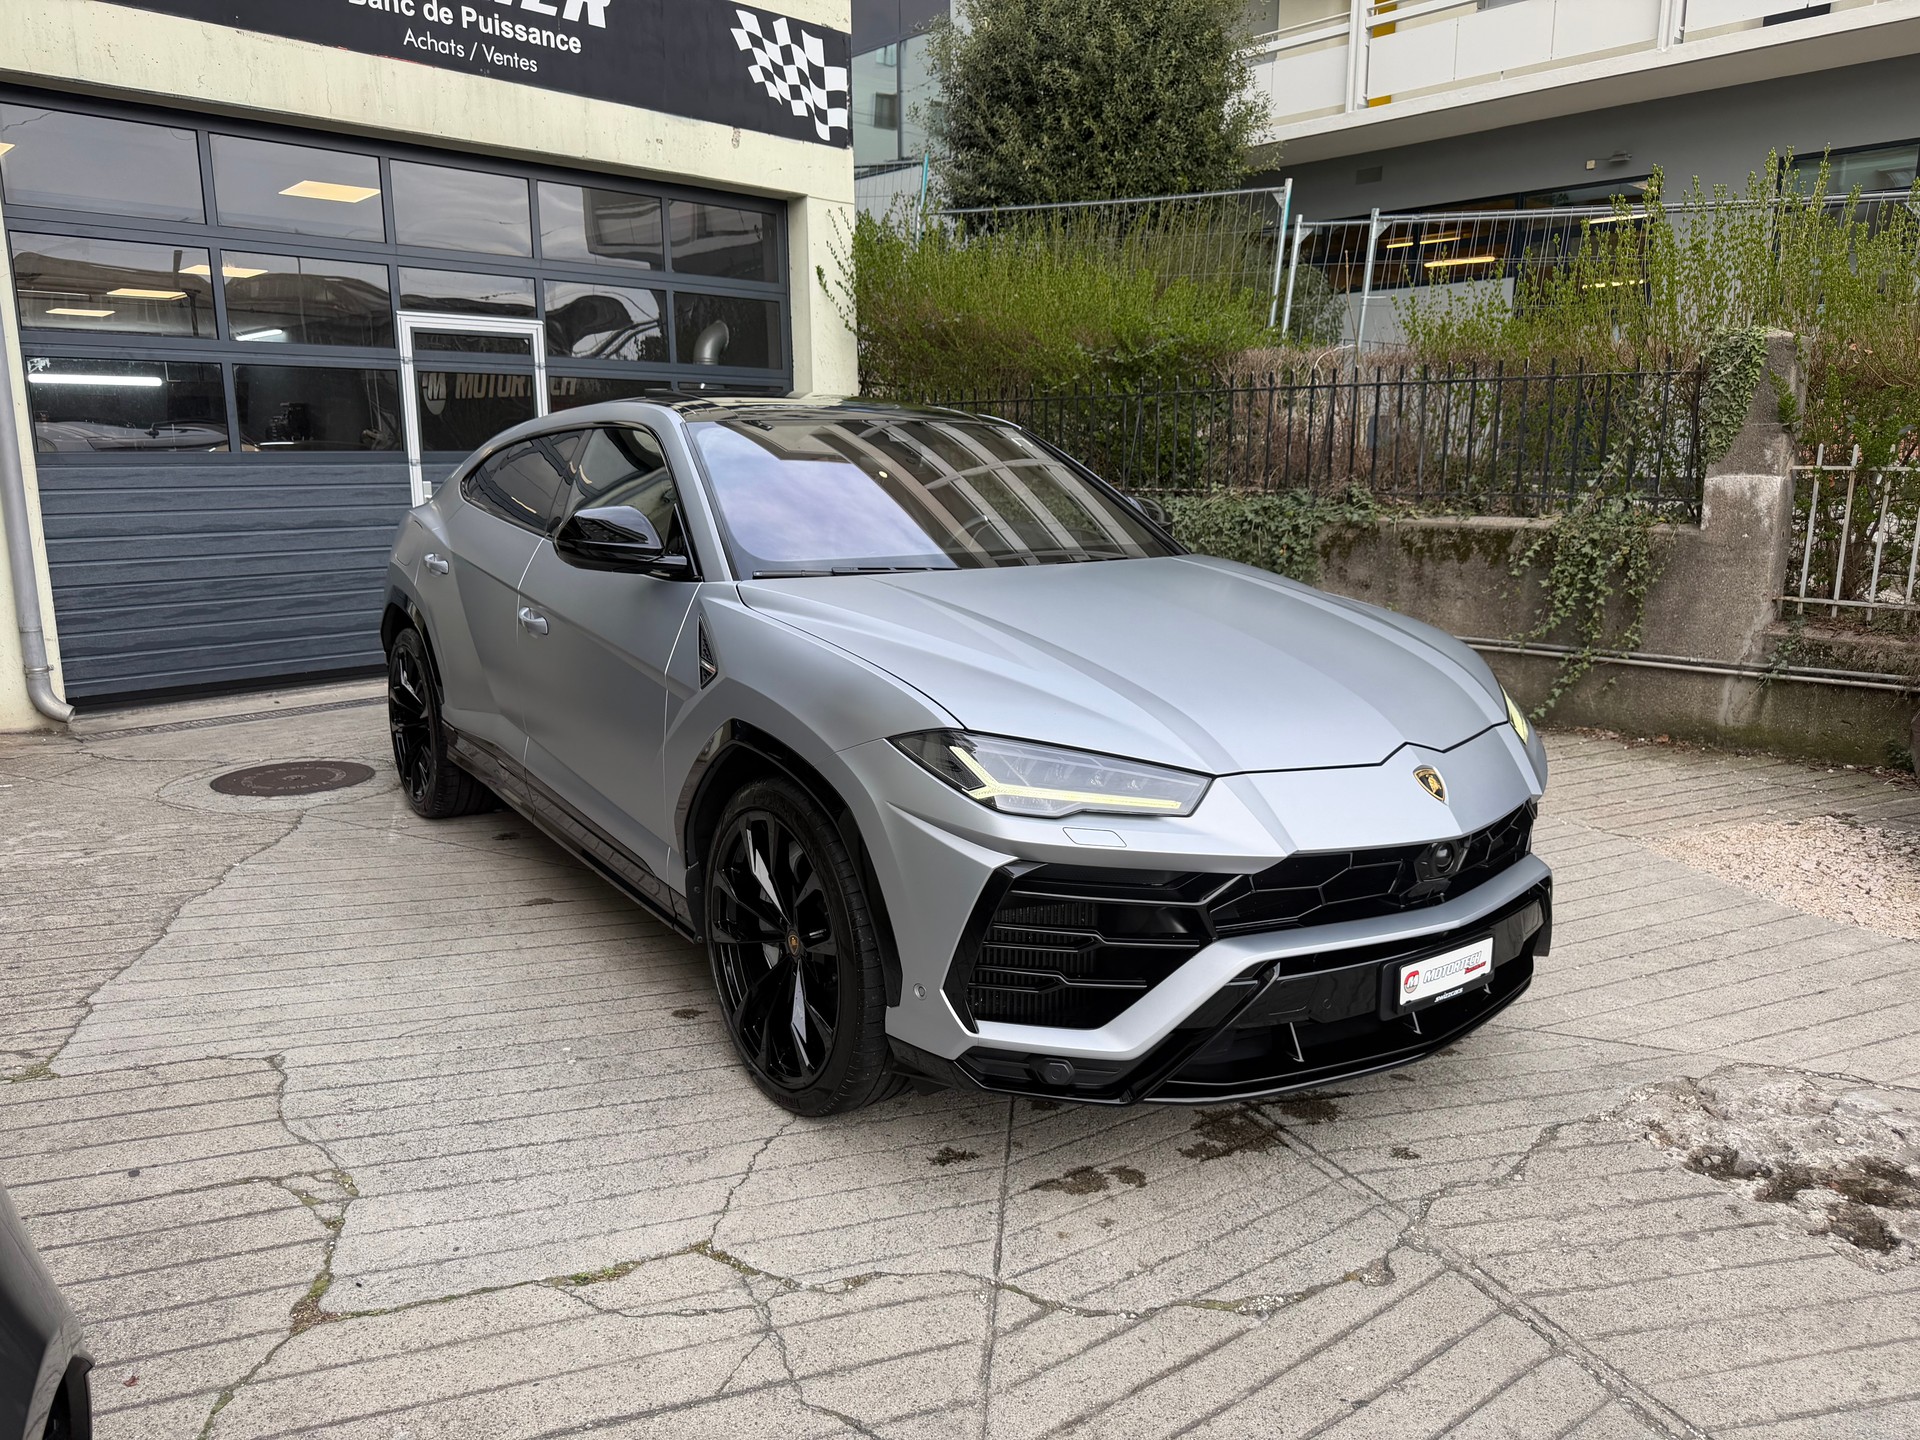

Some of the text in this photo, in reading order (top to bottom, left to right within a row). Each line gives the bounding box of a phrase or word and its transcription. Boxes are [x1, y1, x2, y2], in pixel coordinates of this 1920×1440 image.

[403, 27, 538, 73] Achats / Ventes
[423, 1, 453, 25] de
[461, 6, 582, 54] Puissance
[1423, 951, 1482, 984] MOTORTECH
